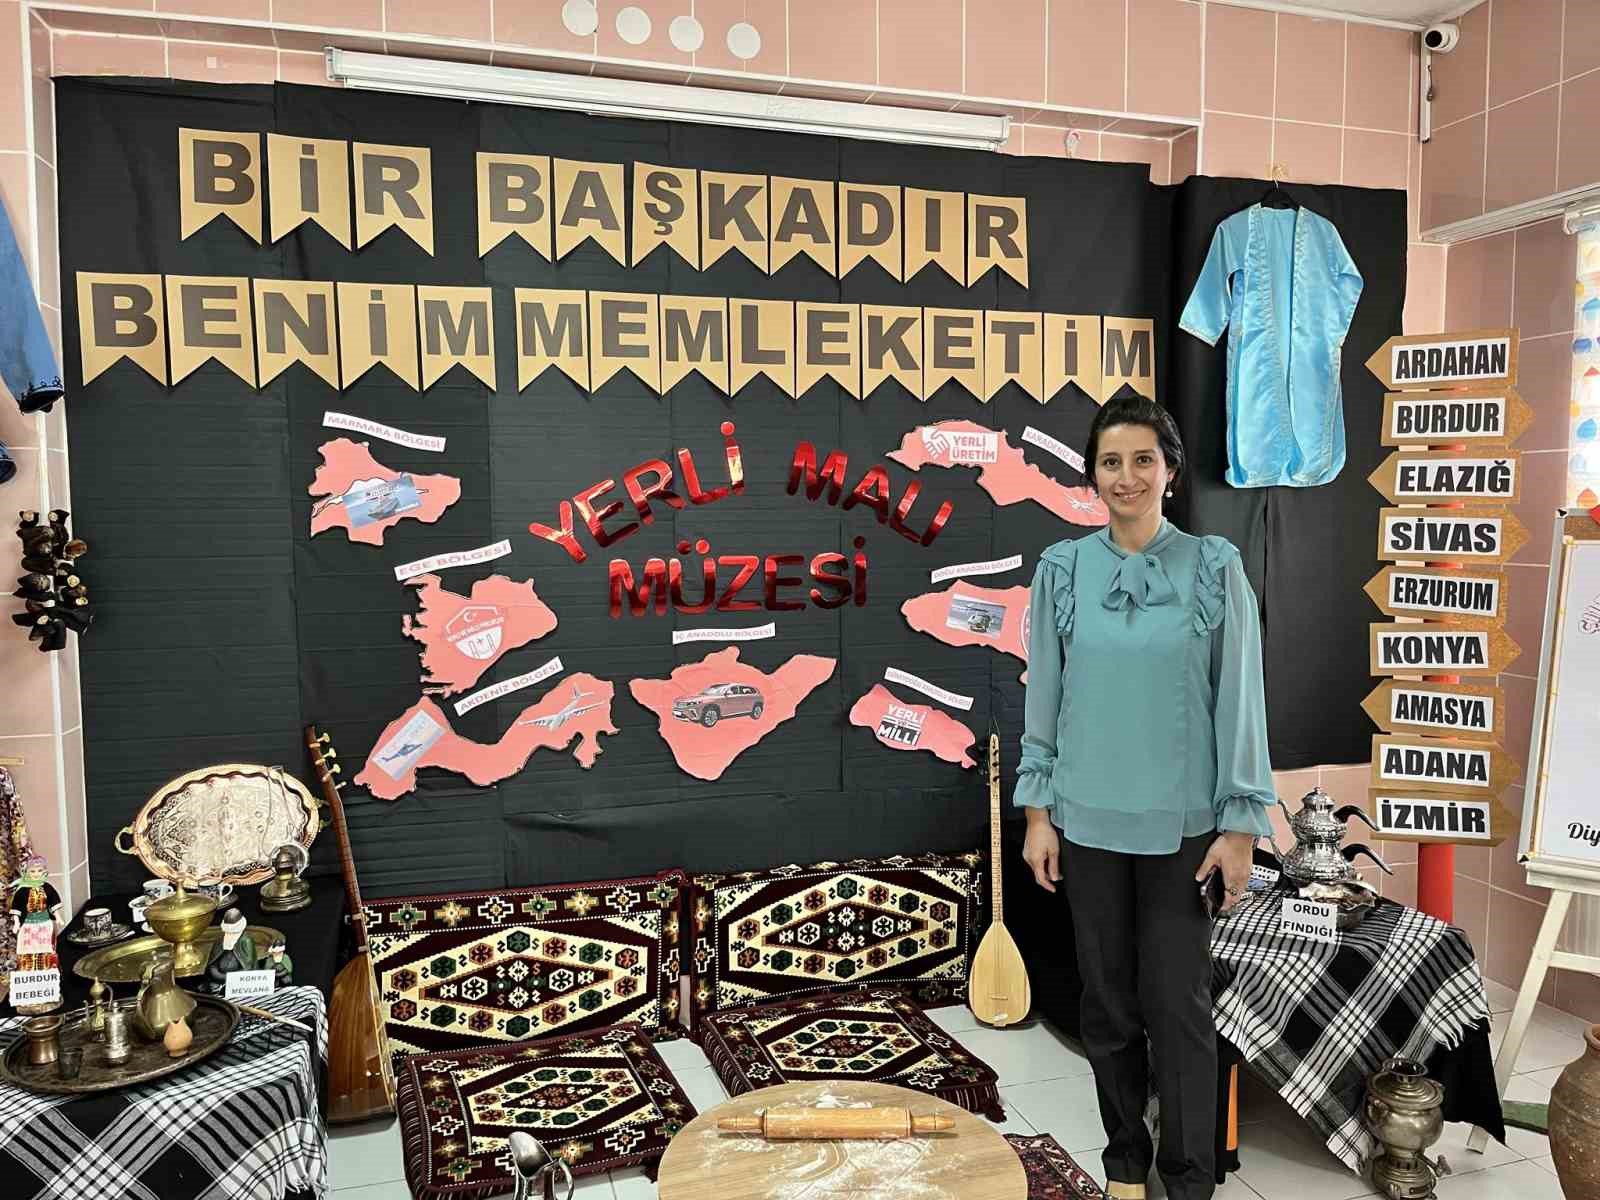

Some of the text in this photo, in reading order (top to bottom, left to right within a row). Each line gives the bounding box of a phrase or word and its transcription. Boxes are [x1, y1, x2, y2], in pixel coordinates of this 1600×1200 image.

[193, 138, 1024, 259] BİR BAŞKADIR
[91, 282, 1153, 378] BENİM MEMLEKETİM
[1395, 343, 1506, 380] ARDAHAN
[328, 415, 391, 437] MARMARA
[1397, 402, 1499, 434] BURDUR
[952, 449, 995, 460] ÜRETİM
[953, 435, 986, 447] YERLİ
[528, 421, 954, 563] YERLİ MALI
[1399, 460, 1511, 494] ELAZIĞ
[1390, 517, 1496, 553] SİVAS
[400, 543, 508, 576] EGE BÖLGESİ
[608, 535, 868, 618] MÜZESİ
[1393, 577, 1493, 612] ERZURUM
[1382, 635, 1484, 665] KONYA
[460, 684, 508, 713] AKDENİZ
[888, 704, 927, 723] YERLİ
[1395, 694, 1486, 728] AMASYA
[879, 724, 920, 746] MİLLİ
[1383, 747, 1487, 782] ADANA
[1381, 799, 1486, 833] İZMİR
[1293, 904, 1330, 917] ORDU
[1283, 921, 1333, 937] FINDIĞI
[14, 974, 58, 984] BURDUR
